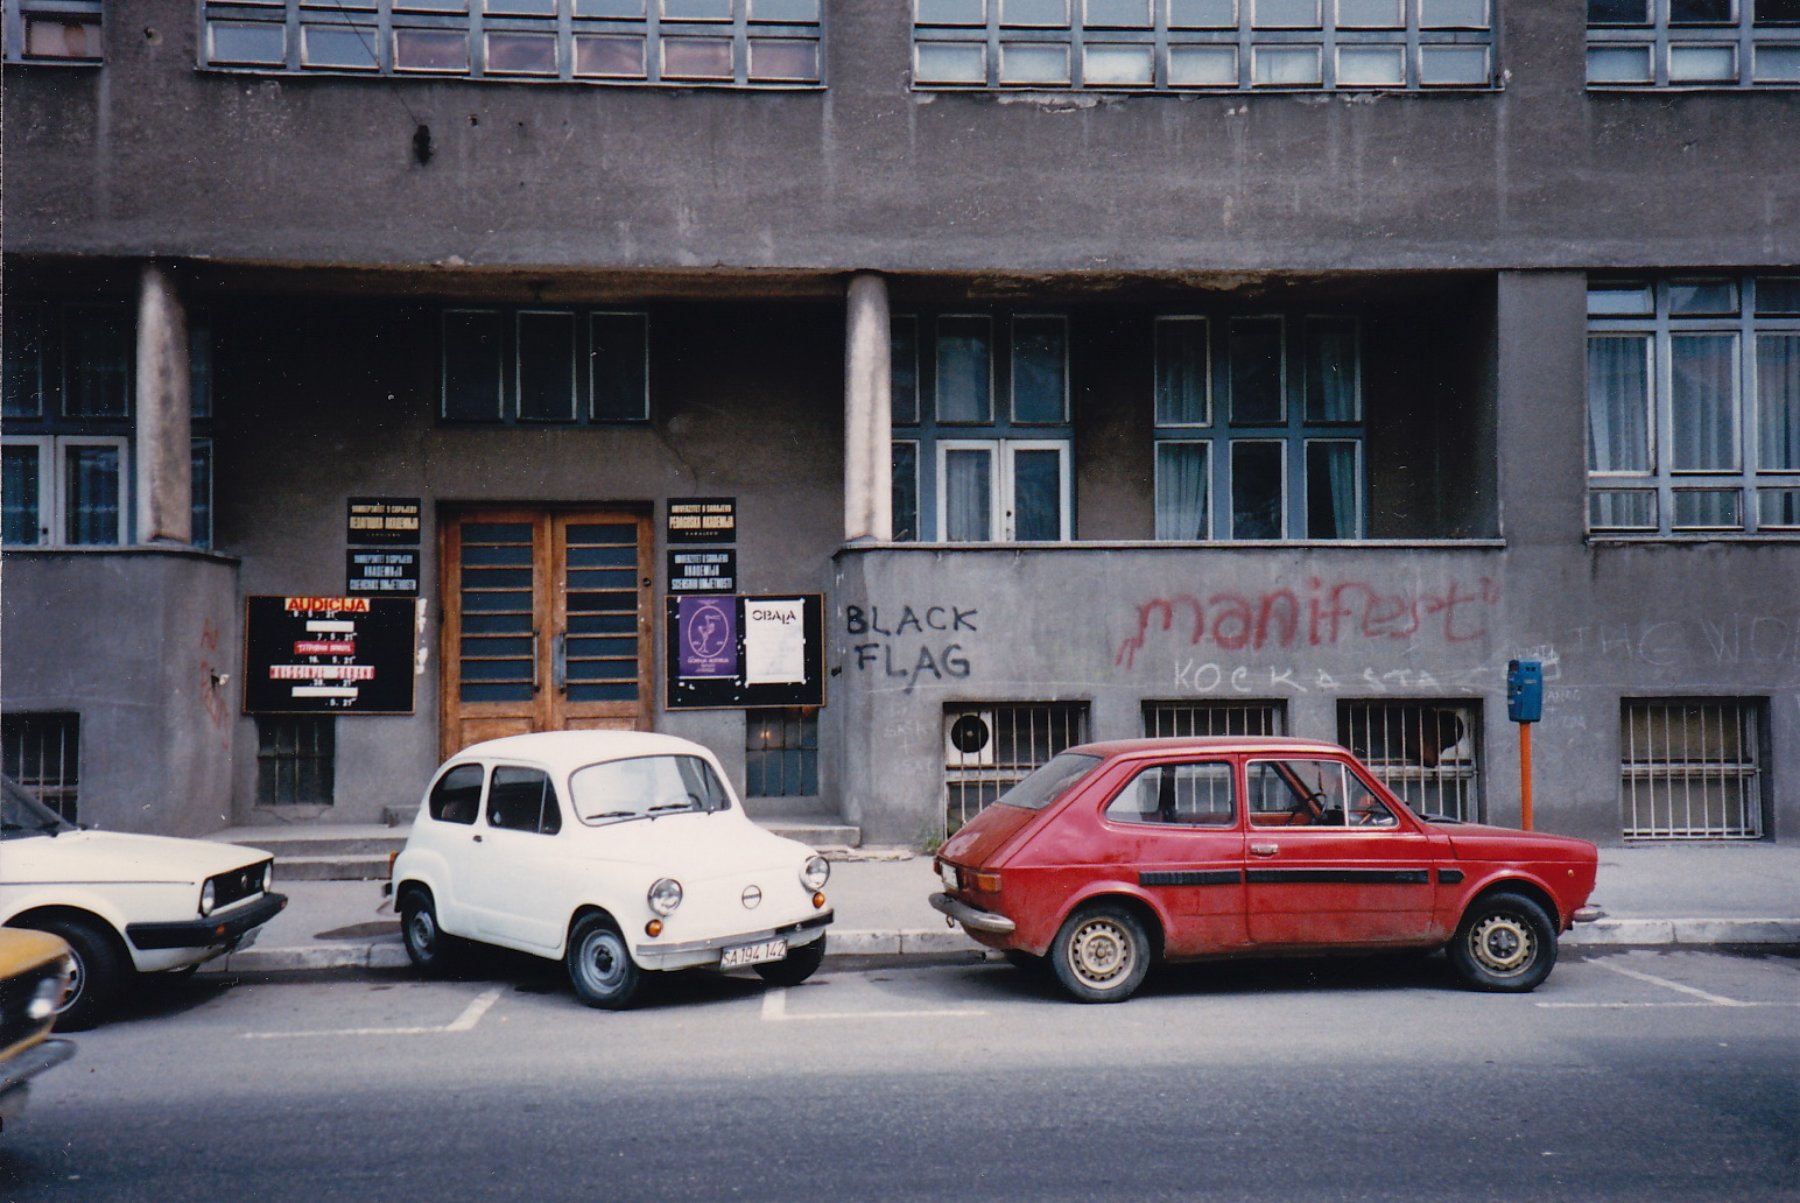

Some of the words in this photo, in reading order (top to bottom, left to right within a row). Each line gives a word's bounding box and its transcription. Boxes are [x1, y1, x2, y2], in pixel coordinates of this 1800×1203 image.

[287, 598, 368, 611] AUDICIJA
[752, 609, 797, 625] OBALA
[846, 605, 978, 636] BLACK
[854, 643, 971, 694] FLAG
[723, 949, 738, 966] SA
[741, 946, 760, 964] 194
[766, 941, 786, 959] 142
